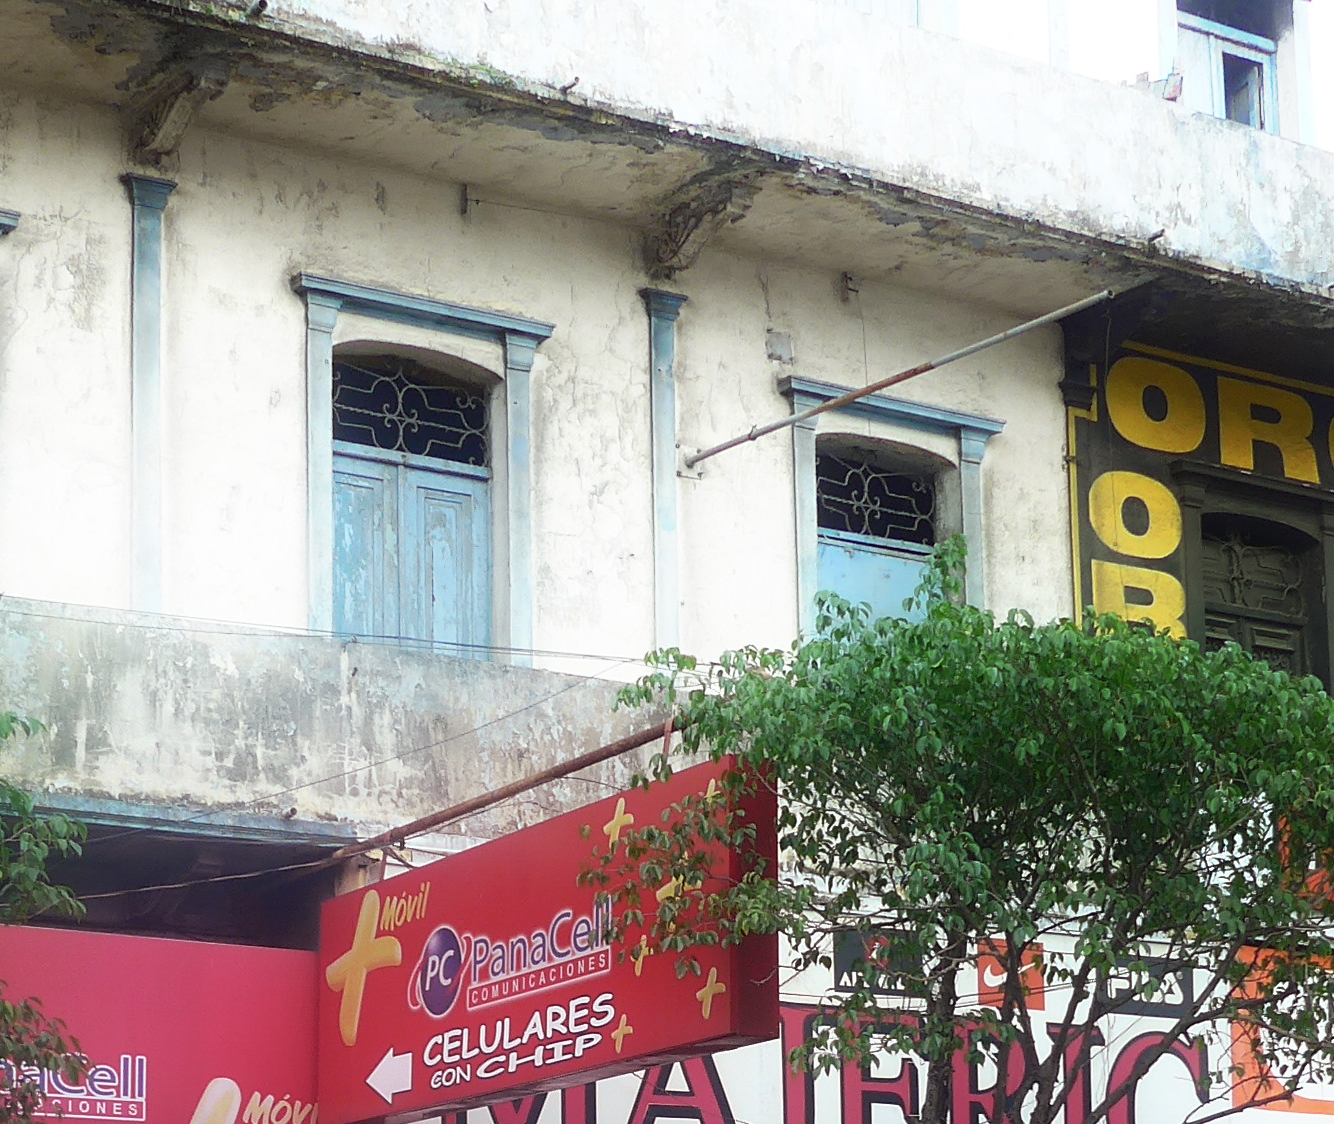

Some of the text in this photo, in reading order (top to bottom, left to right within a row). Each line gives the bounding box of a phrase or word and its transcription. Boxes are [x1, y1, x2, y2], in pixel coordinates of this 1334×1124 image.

[380, 881, 430, 931] Móvil
[470, 893, 612, 984] PanaCell
[425, 949, 455, 991] PC
[471, 953, 607, 1004] COMUNICACIONES
[422, 993, 616, 1067] CELULARES
[430, 1033, 603, 1089] CON CHIP
